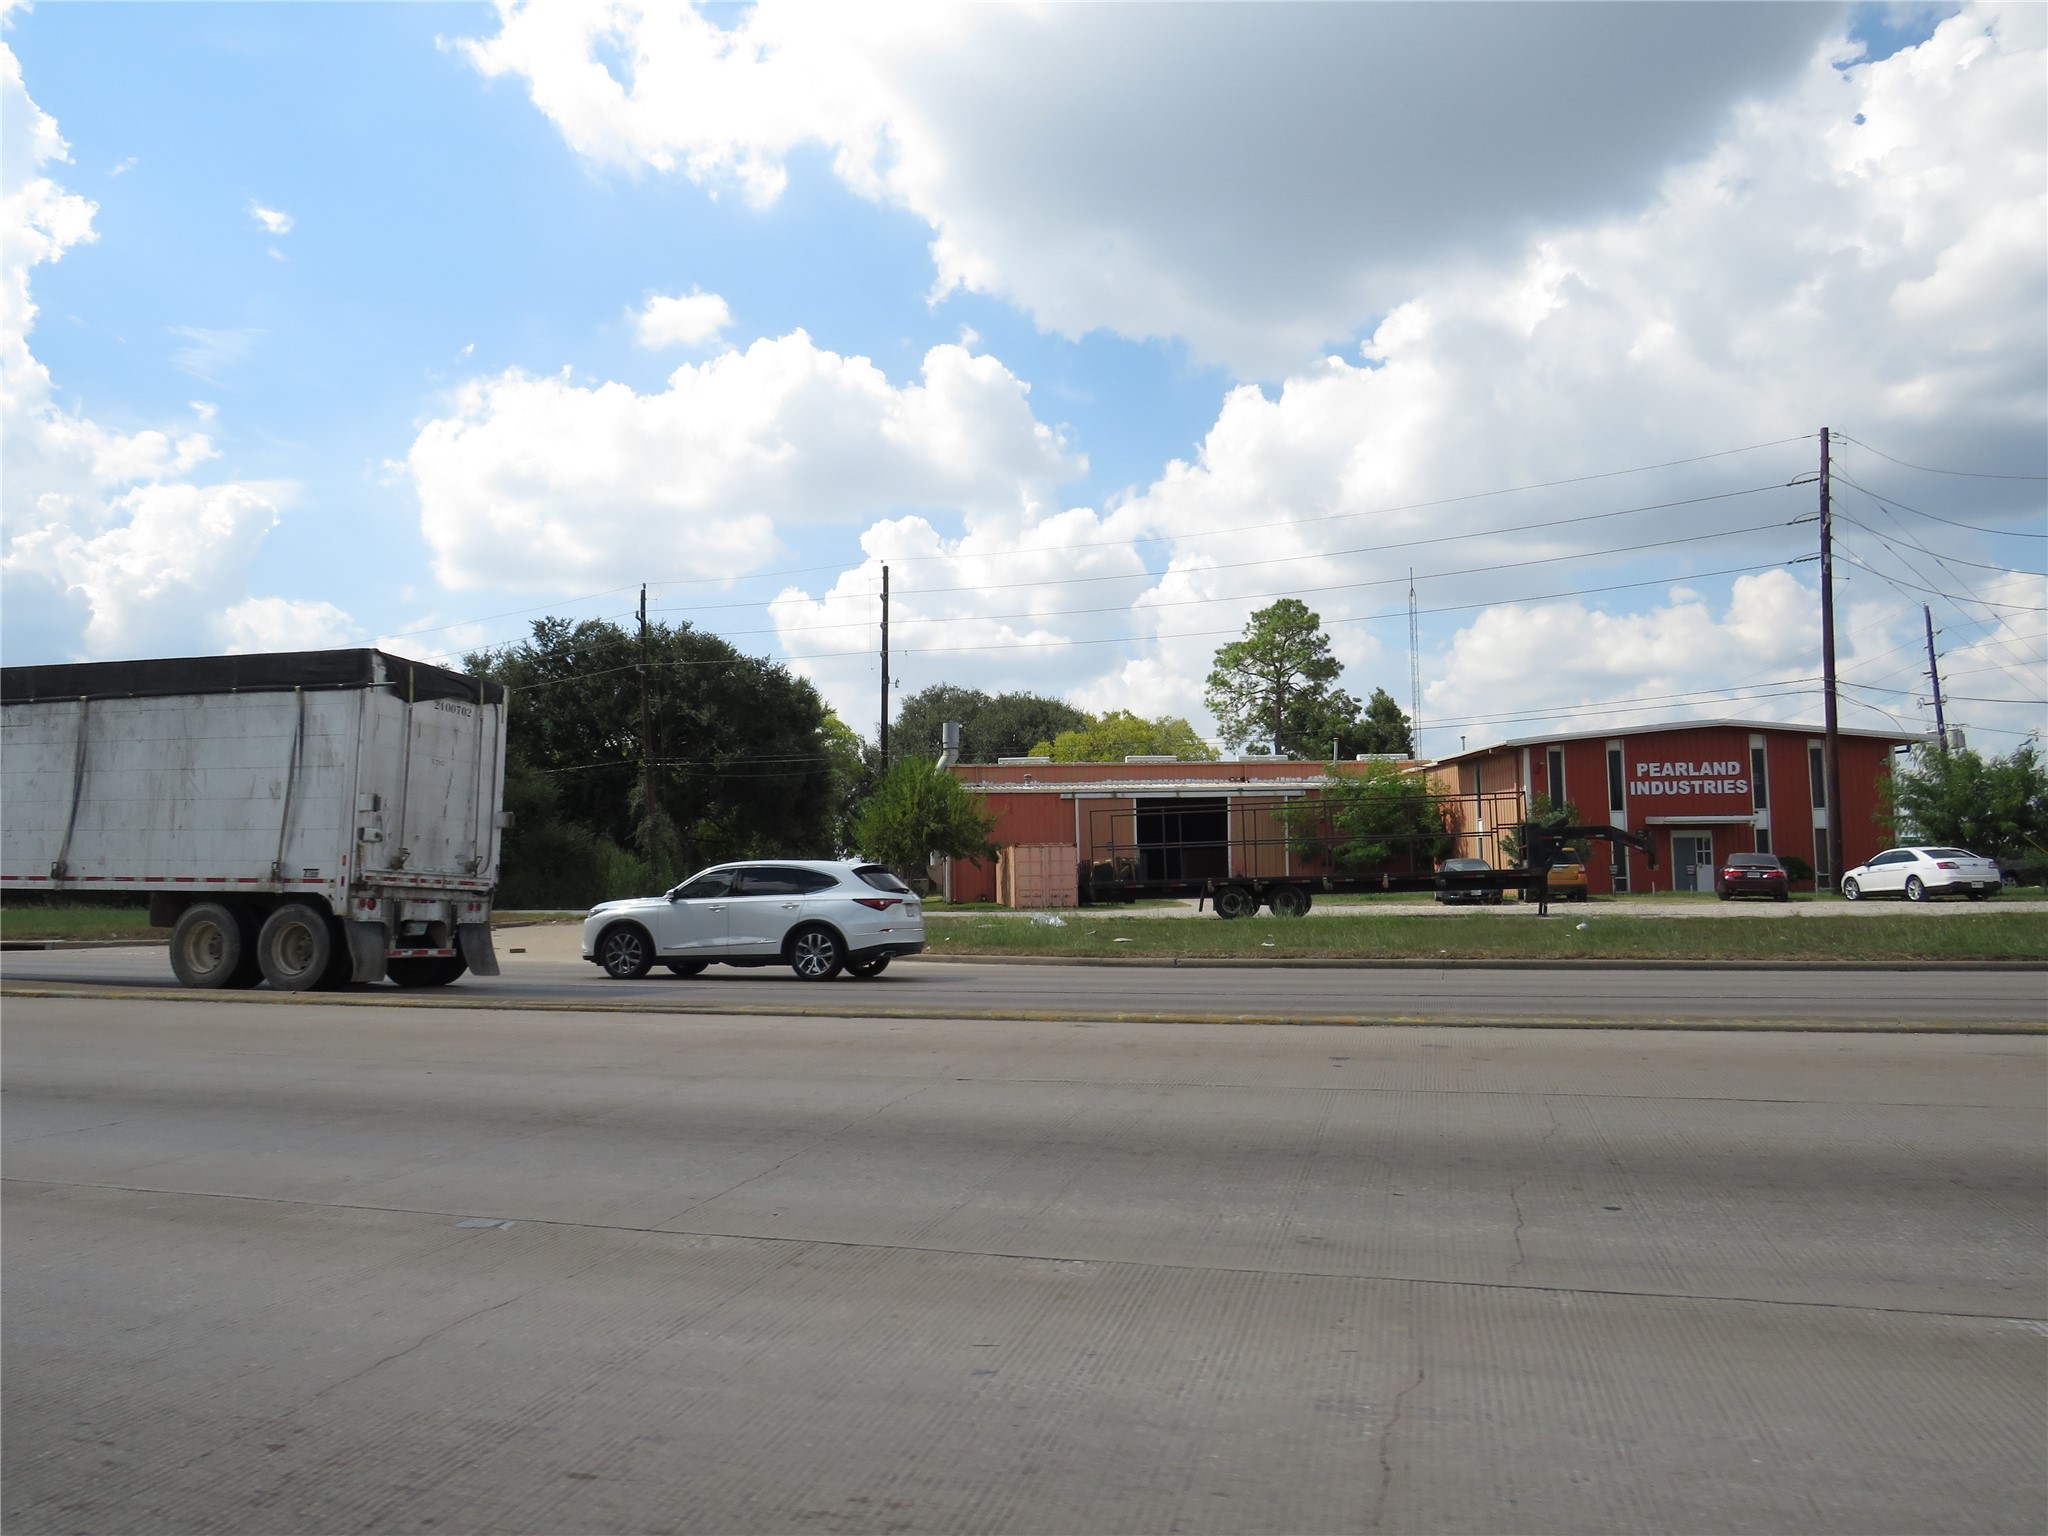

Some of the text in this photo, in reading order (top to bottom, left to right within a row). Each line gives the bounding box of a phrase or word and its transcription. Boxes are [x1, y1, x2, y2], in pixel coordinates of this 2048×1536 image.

[434, 700, 472, 717] 2100702
[1636, 761, 1740, 777] PEARLAND
[1630, 779, 1748, 795] INDUSTRIES
